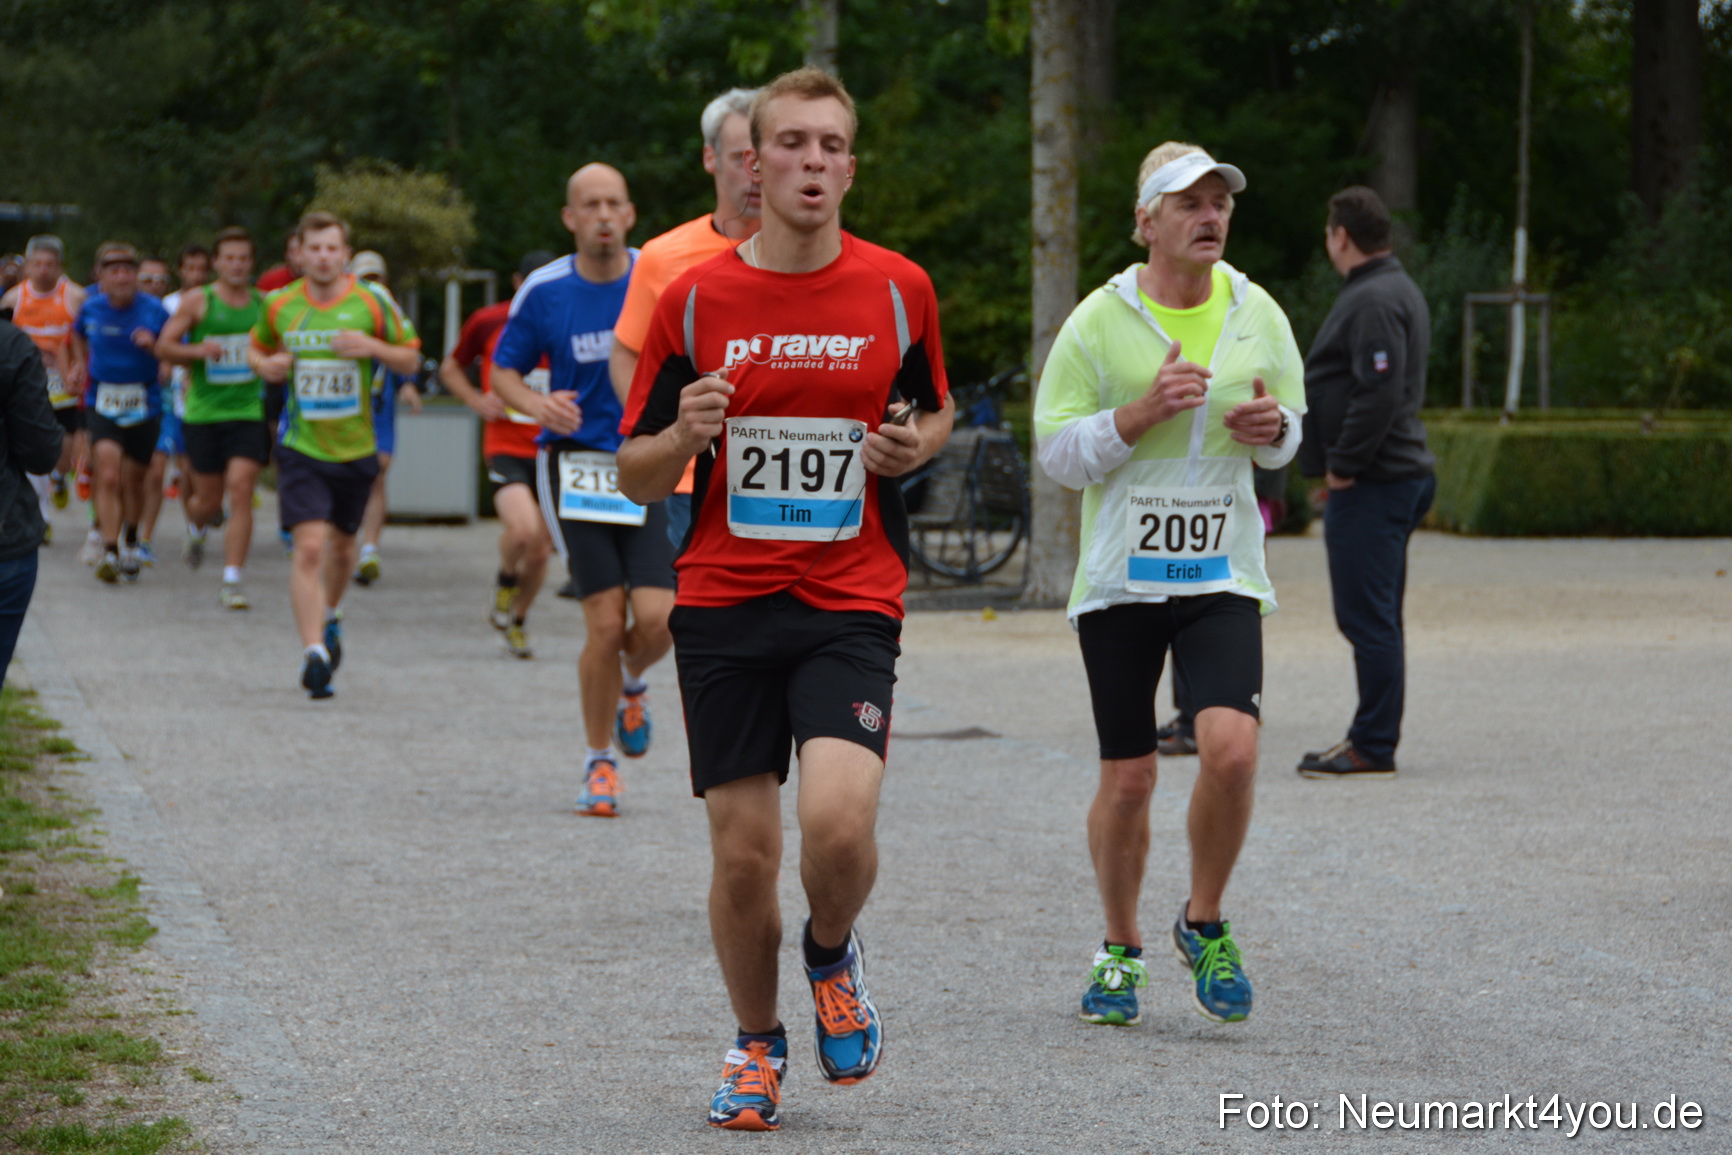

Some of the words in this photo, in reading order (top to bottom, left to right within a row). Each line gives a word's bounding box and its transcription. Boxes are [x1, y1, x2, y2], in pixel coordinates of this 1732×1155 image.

[771, 360, 824, 370] expanded
[829, 360, 859, 371] glass
[731, 427, 775, 440] PARTL
[779, 429, 843, 442] Neumarkt
[741, 446, 854, 493] 2197
[571, 467, 619, 493] 219
[1130, 496, 1168, 508] PARTL
[1172, 497, 1221, 508] Neumarkt
[778, 504, 811, 522] Tim
[1139, 513, 1226, 553] 2097
[1167, 563, 1202, 579] Erich
